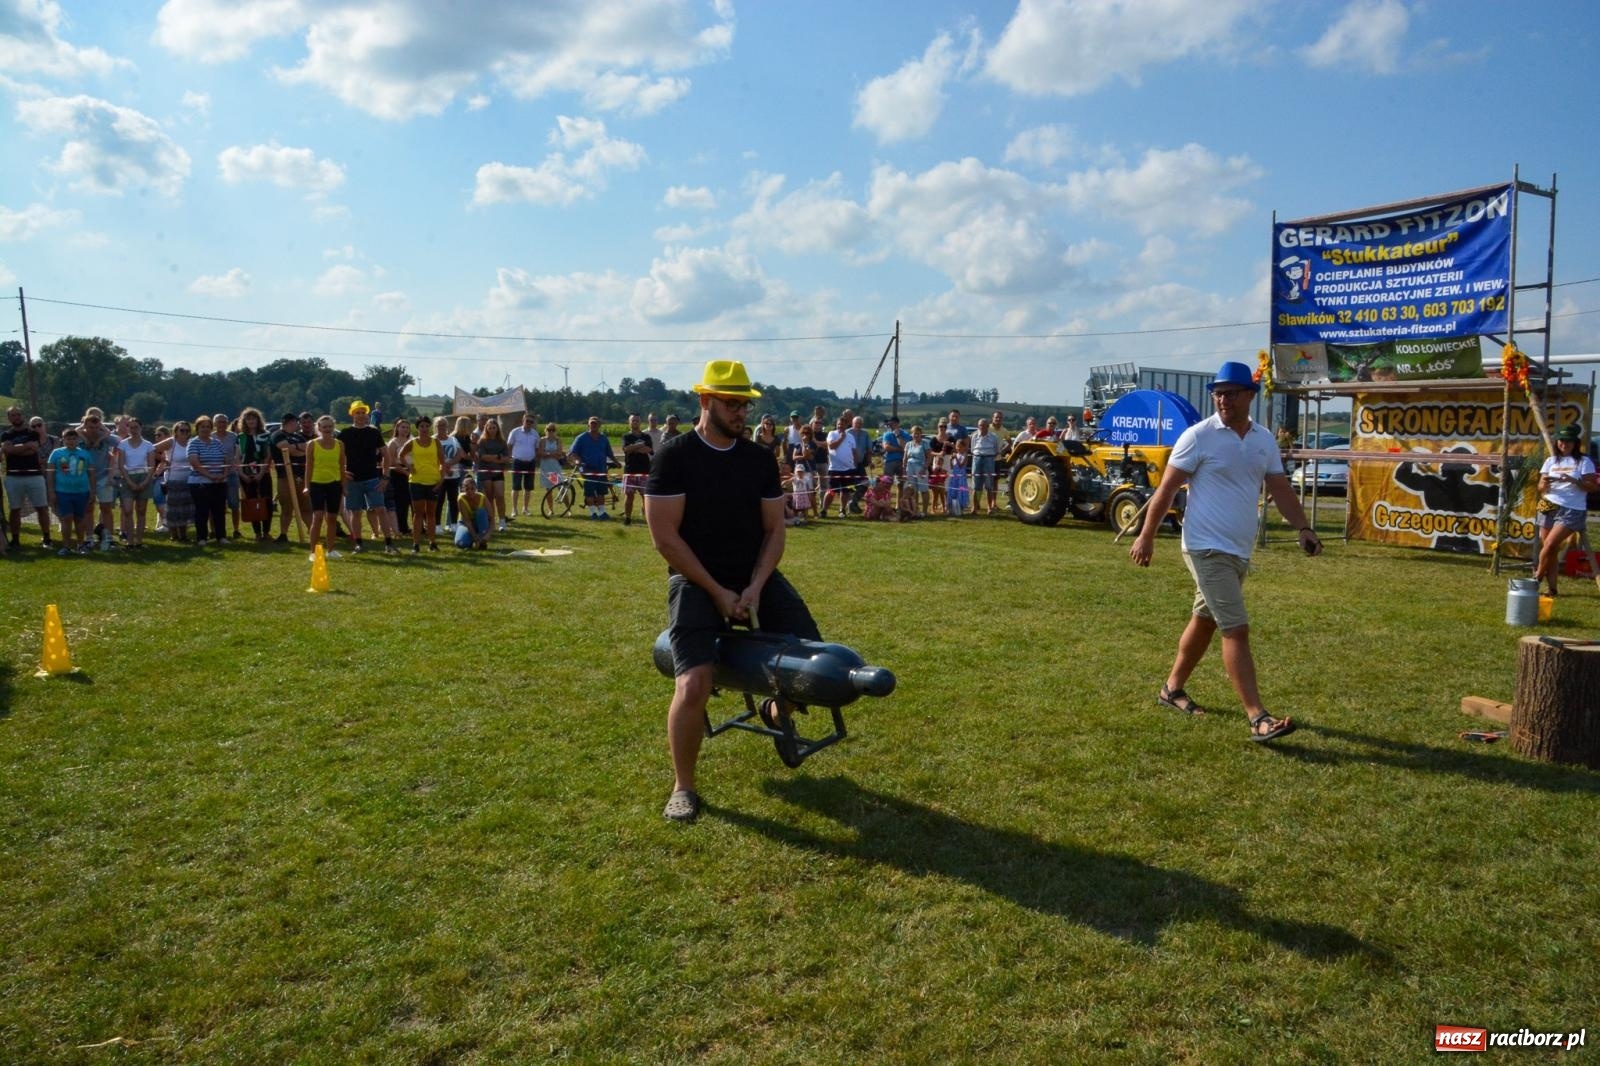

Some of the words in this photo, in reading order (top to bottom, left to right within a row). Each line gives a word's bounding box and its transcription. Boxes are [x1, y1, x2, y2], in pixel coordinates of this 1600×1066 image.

[1279, 222, 1391, 248] GERARD
[1395, 192, 1508, 235] FITZON
[1315, 267, 1383, 282] OCIEPLANIE
[1386, 257, 1455, 276] BUDYNKÓW
[1313, 281, 1383, 295] PRODUKCJA
[1386, 270, 1464, 288] SZTUKATERII
[1314, 295, 1347, 307] TYNKI
[1350, 287, 1432, 305] DEKORACYJNE
[1434, 284, 1462, 297] ZEW.
[1473, 278, 1505, 292] WEW.
[1278, 312, 1335, 327] Sławików
[1338, 310, 1351, 324] 32
[1354, 309, 1377, 322] 410
[1381, 307, 1397, 321] 63
[1400, 305, 1419, 322] 30,
[1423, 303, 1447, 318] 603
[1451, 300, 1474, 314] 703
[1479, 296, 1505, 311] 192
[1318, 321, 1456, 340] www.sztukateria-fitzon.pl
[1396, 343, 1420, 355] KOŁO
[1422, 338, 1478, 354] ŁOWIECKIE
[1396, 362, 1415, 374] NR.
[1417, 362, 1424, 374] 1
[1111, 430, 1138, 442] studio
[1375, 504, 1535, 540] Grzegorzowce
